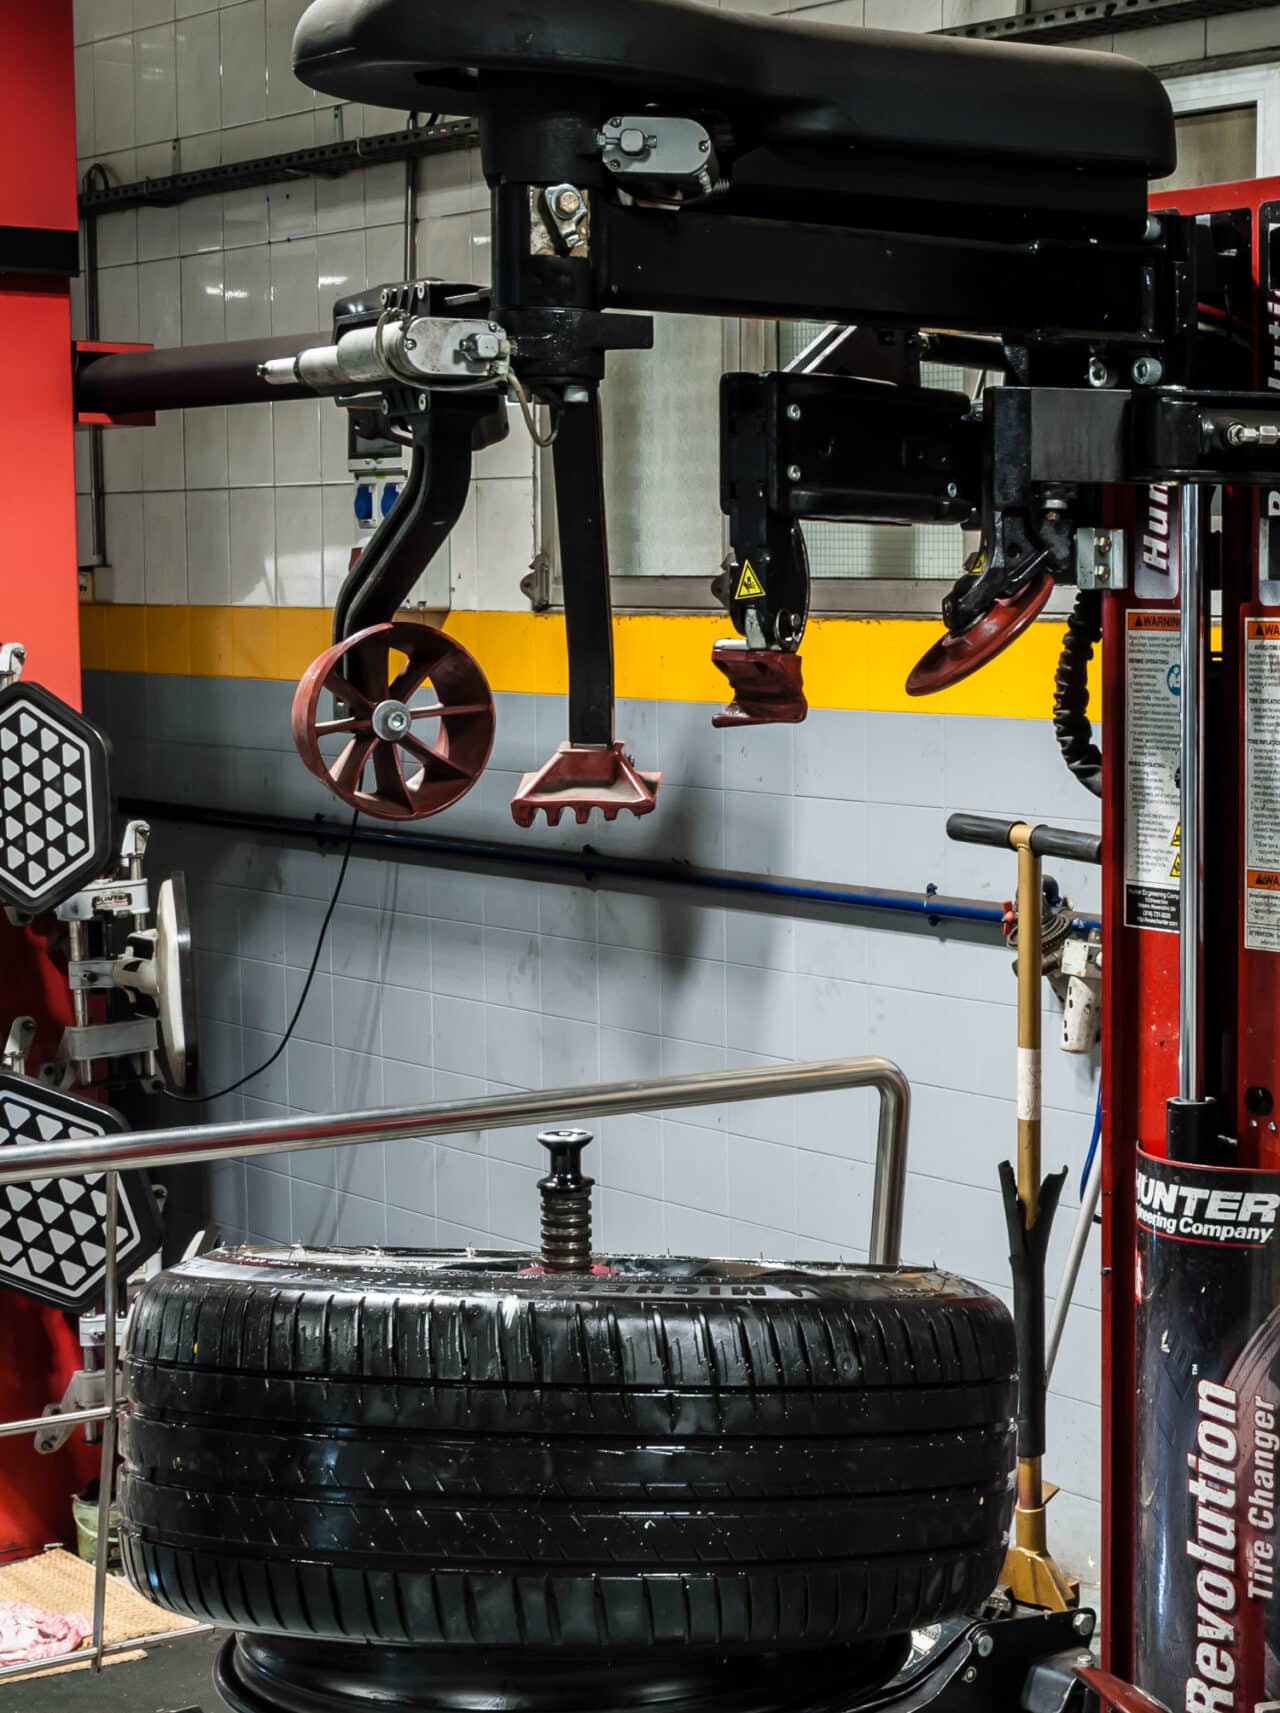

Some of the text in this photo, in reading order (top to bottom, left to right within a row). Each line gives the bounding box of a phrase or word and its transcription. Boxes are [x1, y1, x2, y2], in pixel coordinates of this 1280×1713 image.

[1179, 1217, 1274, 1243] Company
[1247, 1396, 1280, 1600] Tire Changer
